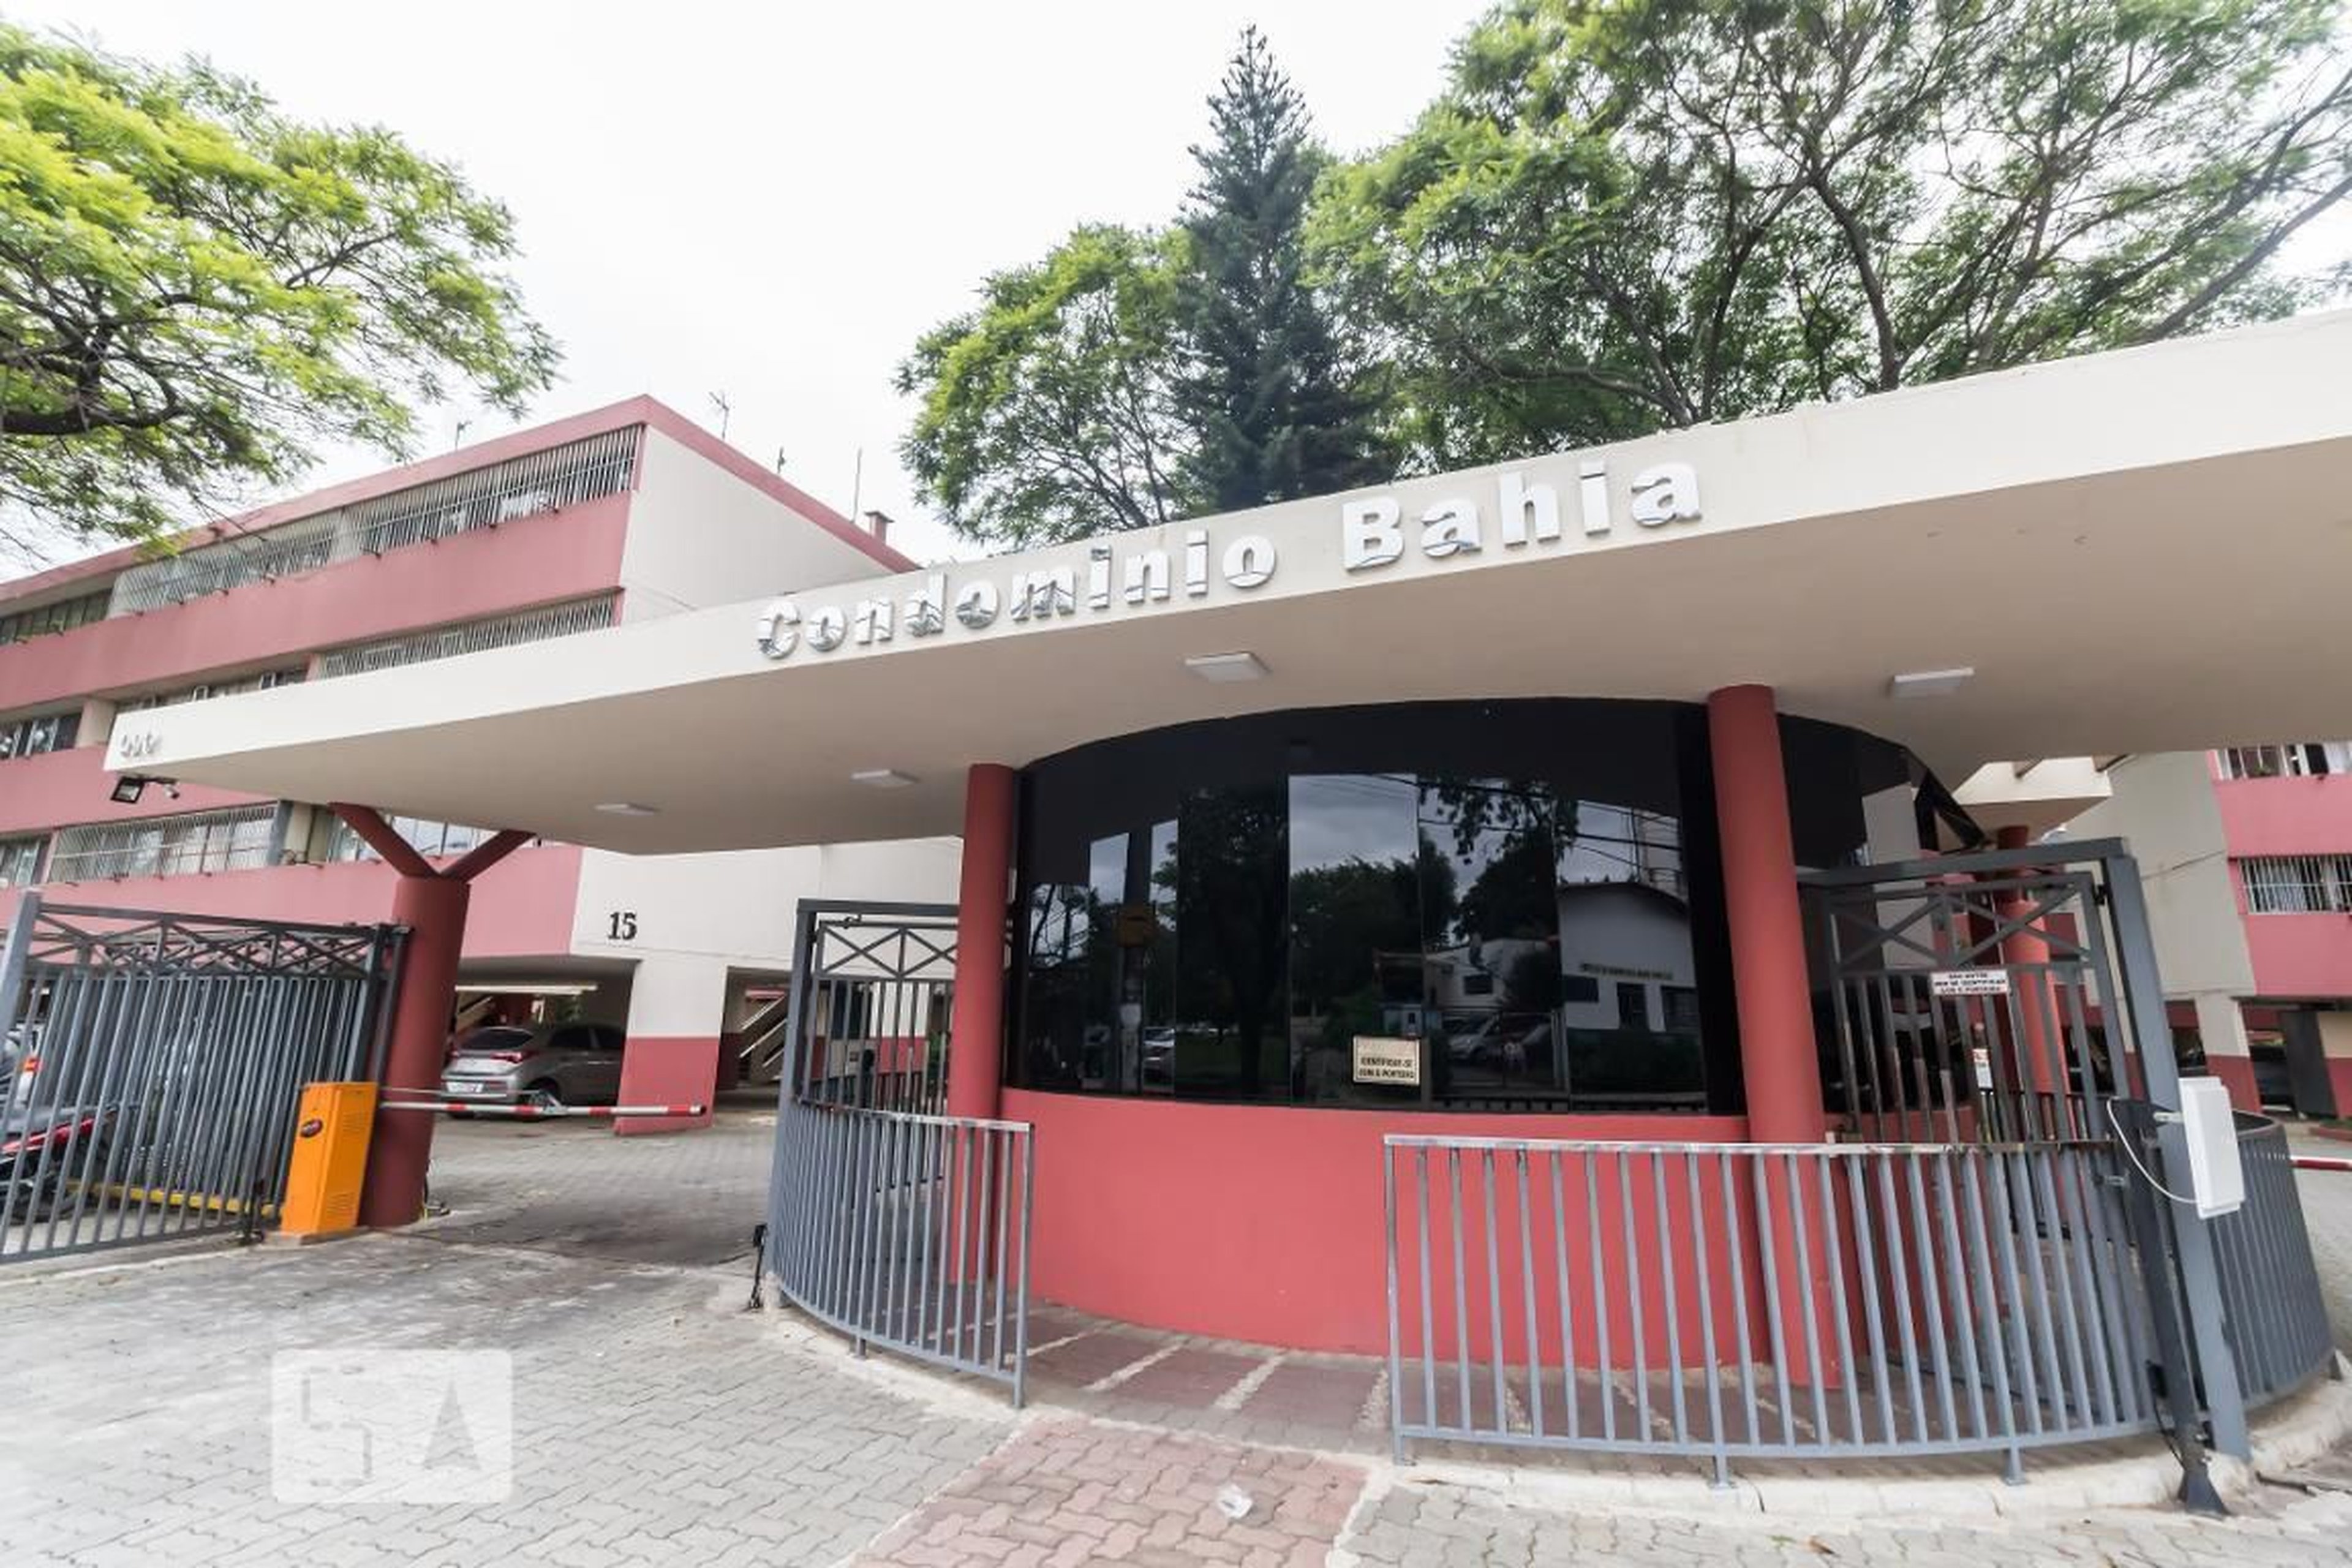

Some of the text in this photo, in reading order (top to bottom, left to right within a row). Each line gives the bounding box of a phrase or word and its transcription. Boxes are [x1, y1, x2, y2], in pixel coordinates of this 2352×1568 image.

[757, 459, 1703, 660] Condominio Bahia
[608, 911, 637, 940] 15
